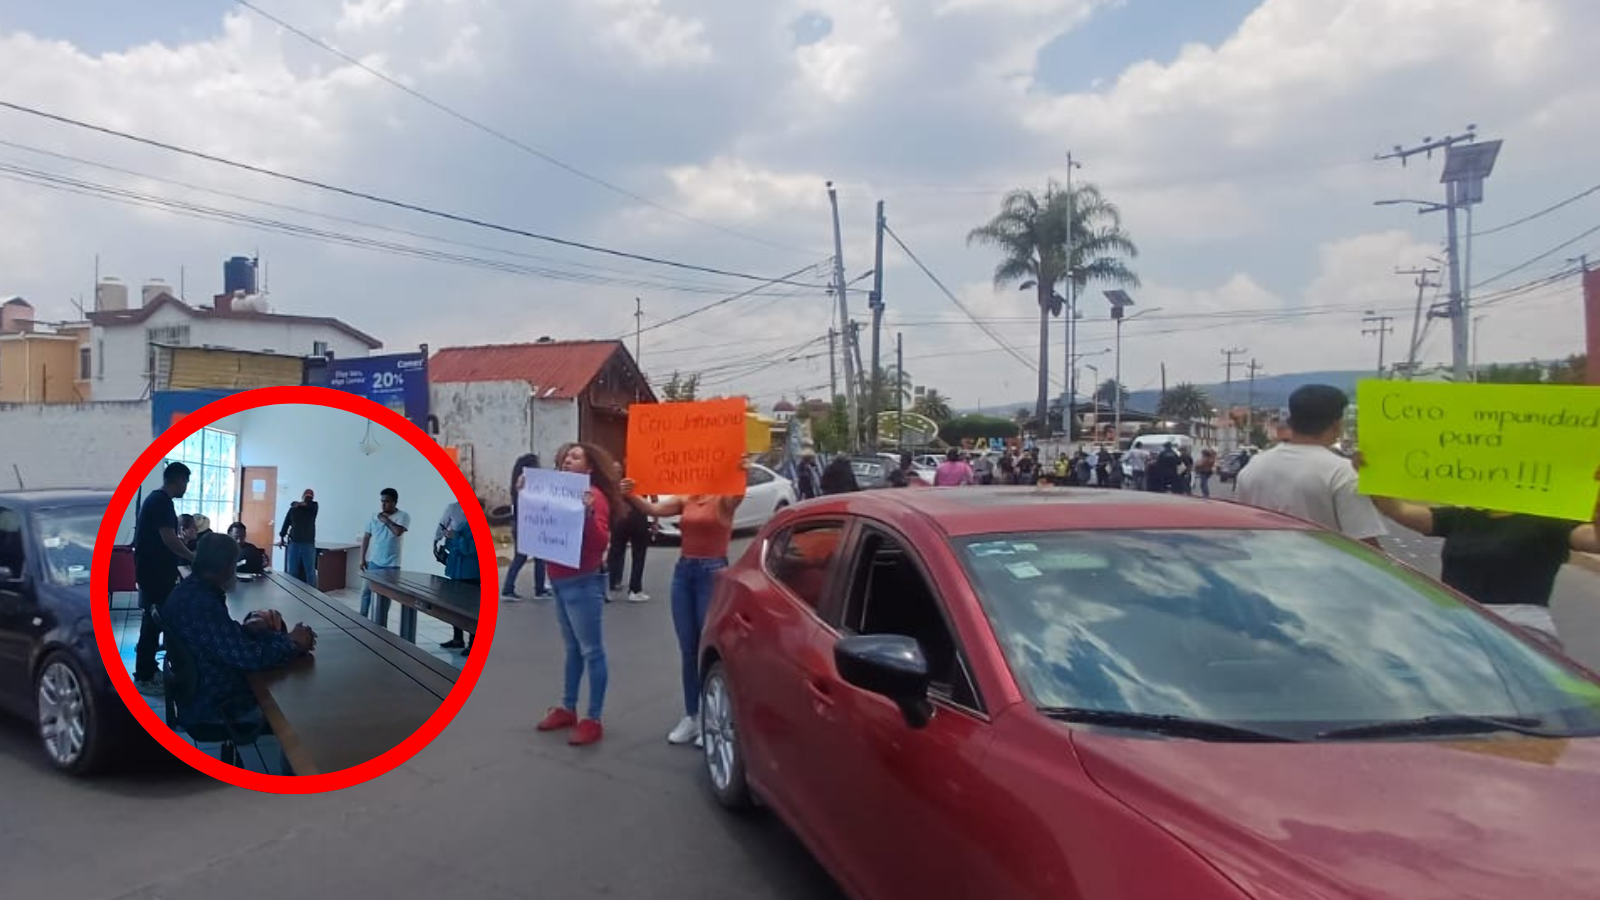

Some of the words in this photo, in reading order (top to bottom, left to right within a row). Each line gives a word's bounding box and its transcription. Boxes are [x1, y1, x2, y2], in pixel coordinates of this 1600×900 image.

[373, 372, 403, 388] 20%
[1381, 392, 1444, 421] Cero
[1473, 407, 1600, 431] impunidad
[1439, 430, 1503, 448] para
